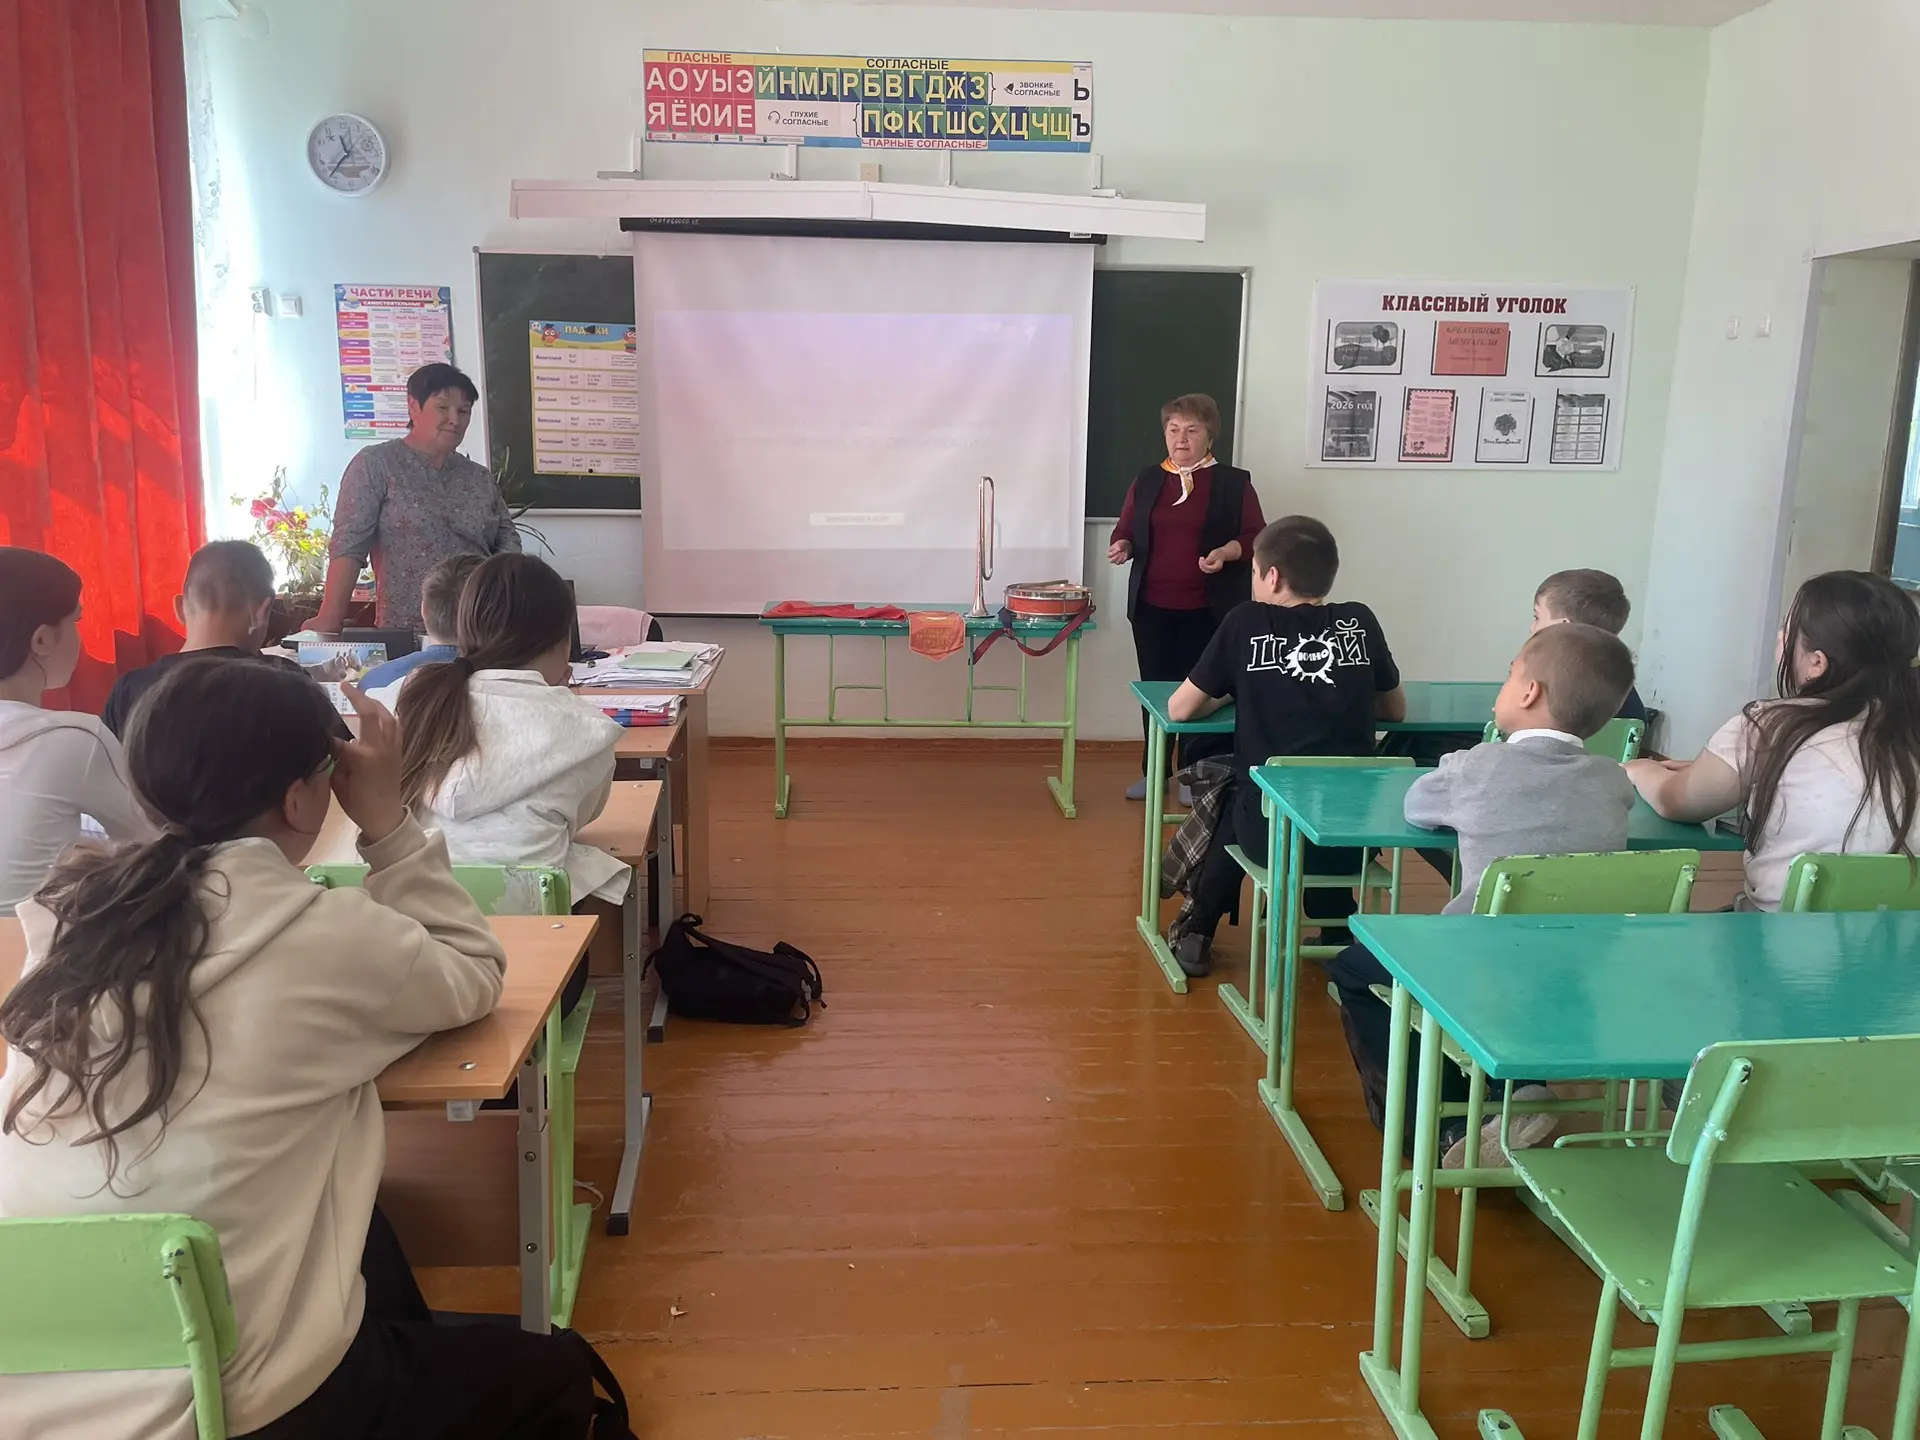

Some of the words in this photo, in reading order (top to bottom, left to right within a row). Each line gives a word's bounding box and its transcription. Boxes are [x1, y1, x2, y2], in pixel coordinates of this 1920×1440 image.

[667, 52, 732, 63] ГЛАСНЫЕ
[866, 58, 949, 70] СОГЛАСНЫЕ
[1019, 81, 1054, 89] ЗВОНКИЕ
[1014, 89, 1061, 97] СОГЛАСНЫЕ
[782, 118, 829, 126] СОГЛАСНЫЕ
[868, 138, 914, 148] ПАРНЫЕ
[916, 139, 982, 149] СОГЛАСНЫЕ
[349, 288, 394, 298] ЧАСТИ
[398, 289, 432, 299] РЕЧИ
[1382, 292, 1489, 313] КЛАССНЫЙ
[1496, 297, 1568, 314] УГОЛОК
[1330, 401, 1354, 410] 2026
[1357, 402, 1373, 411] год
[1298, 648, 1330, 662] КИНО
